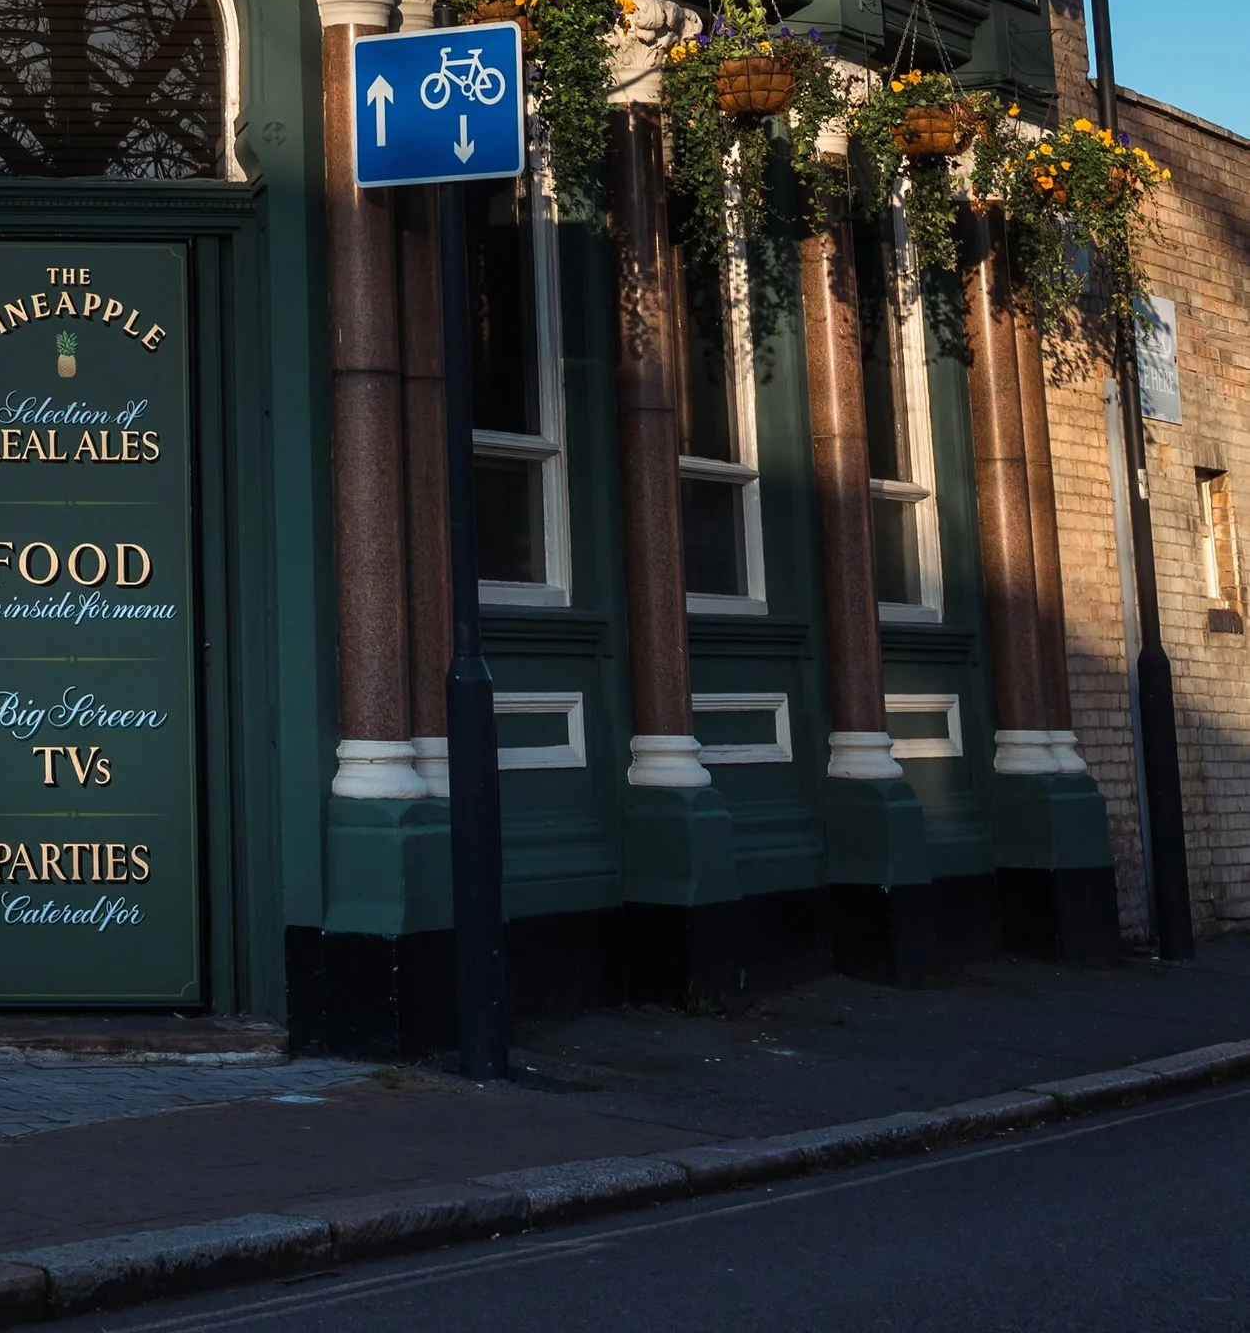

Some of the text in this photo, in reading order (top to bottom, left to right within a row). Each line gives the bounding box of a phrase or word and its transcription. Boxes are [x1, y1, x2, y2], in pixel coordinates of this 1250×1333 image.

[47, 268, 91, 285] THE
[111, 399, 148, 429] of
[74, 430, 160, 461] ALES
[3, 592, 76, 619] inside
[74, 591, 112, 624] for
[112, 604, 177, 619] menu
[47, 686, 168, 727] Screen
[32, 746, 112, 785] TVs
[1, 891, 145, 931] Catered for
